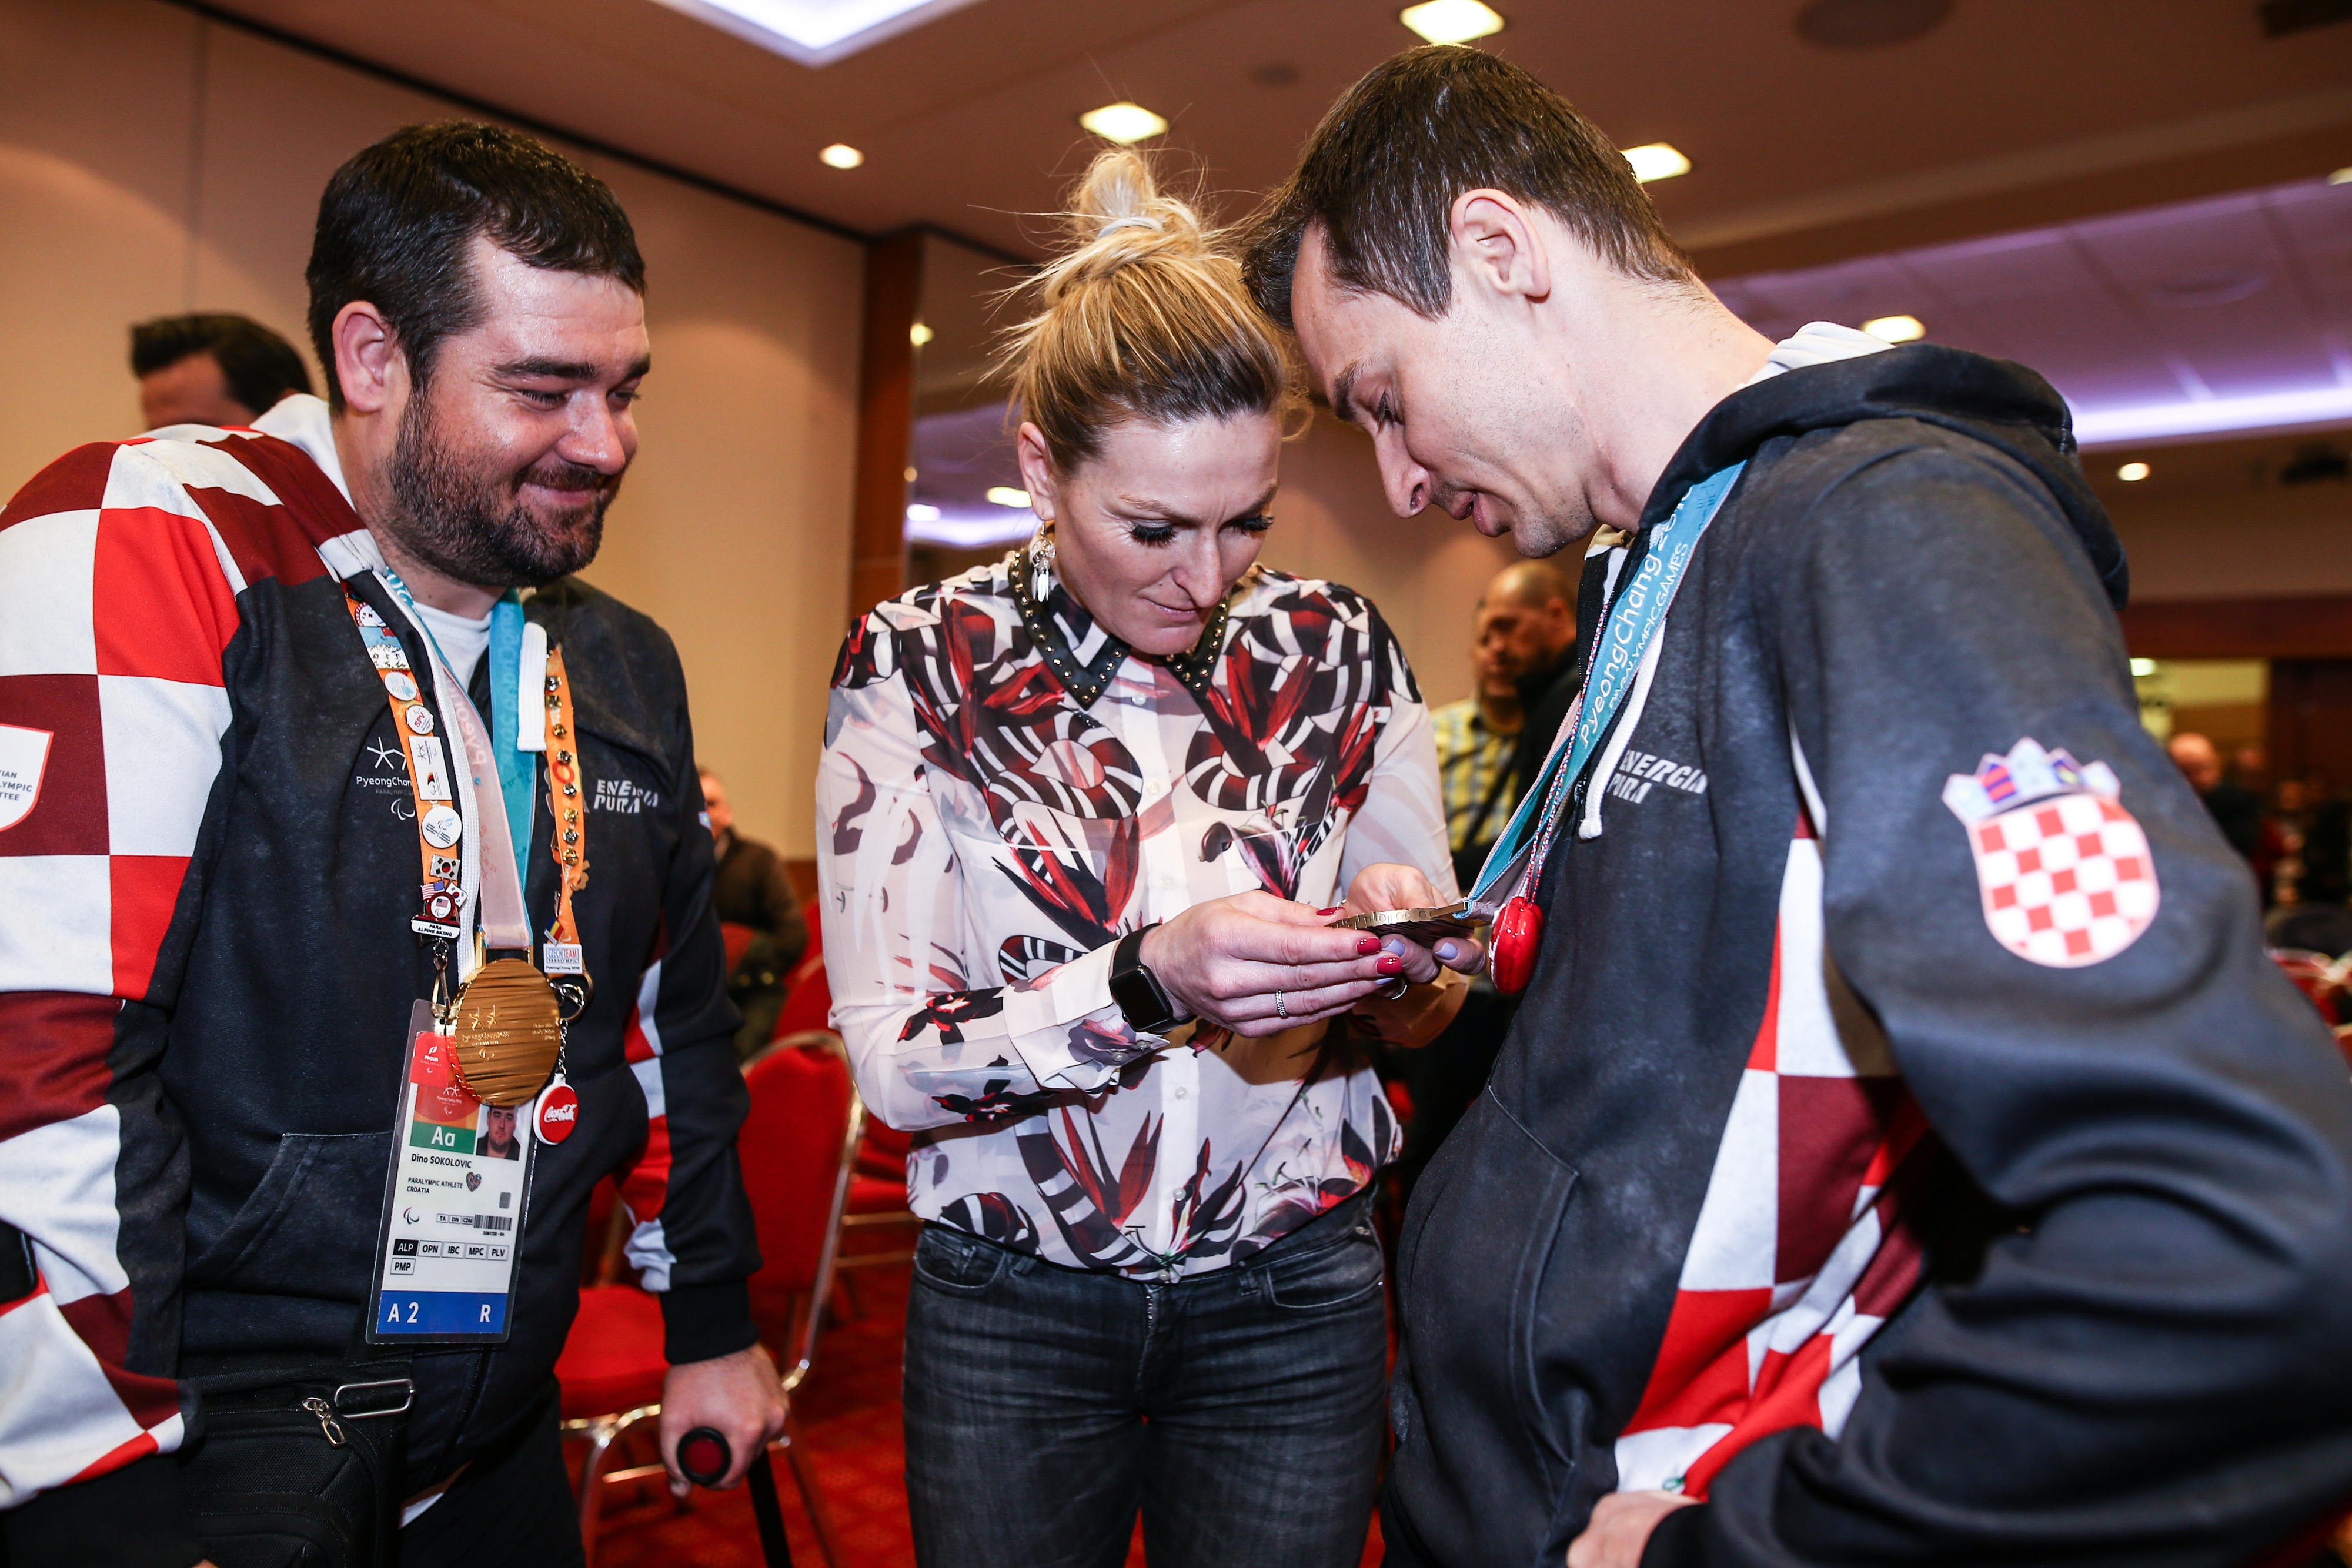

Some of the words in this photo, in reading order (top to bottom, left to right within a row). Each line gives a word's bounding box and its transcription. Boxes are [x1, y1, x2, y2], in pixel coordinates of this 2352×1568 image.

[1655, 542, 1688, 607] GAMES
[1580, 553, 1662, 749] PyeongChang
[414, 711, 425, 727] SPV
[0, 781, 33, 792] YMPIC
[1606, 773, 1652, 804] PURA
[593, 794, 640, 814] PURA
[548, 948, 563, 958] CZECH
[563, 948, 577, 958] TEAM
[431, 1126, 456, 1147] Aa
[411, 1153, 429, 1163] Dino
[430, 1156, 472, 1168] SOKOLOVIC
[408, 1177, 440, 1186] PARALYMPIC
[398, 1243, 414, 1252] ALP
[422, 1245, 439, 1253] OPN
[447, 1246, 460, 1255] IBC
[469, 1246, 485, 1256] MPC
[492, 1248, 506, 1257] PLV
[395, 1262, 412, 1271] PMP
[387, 1303, 400, 1322] A
[406, 1301, 419, 1323] 2
[479, 1303, 492, 1323] R
